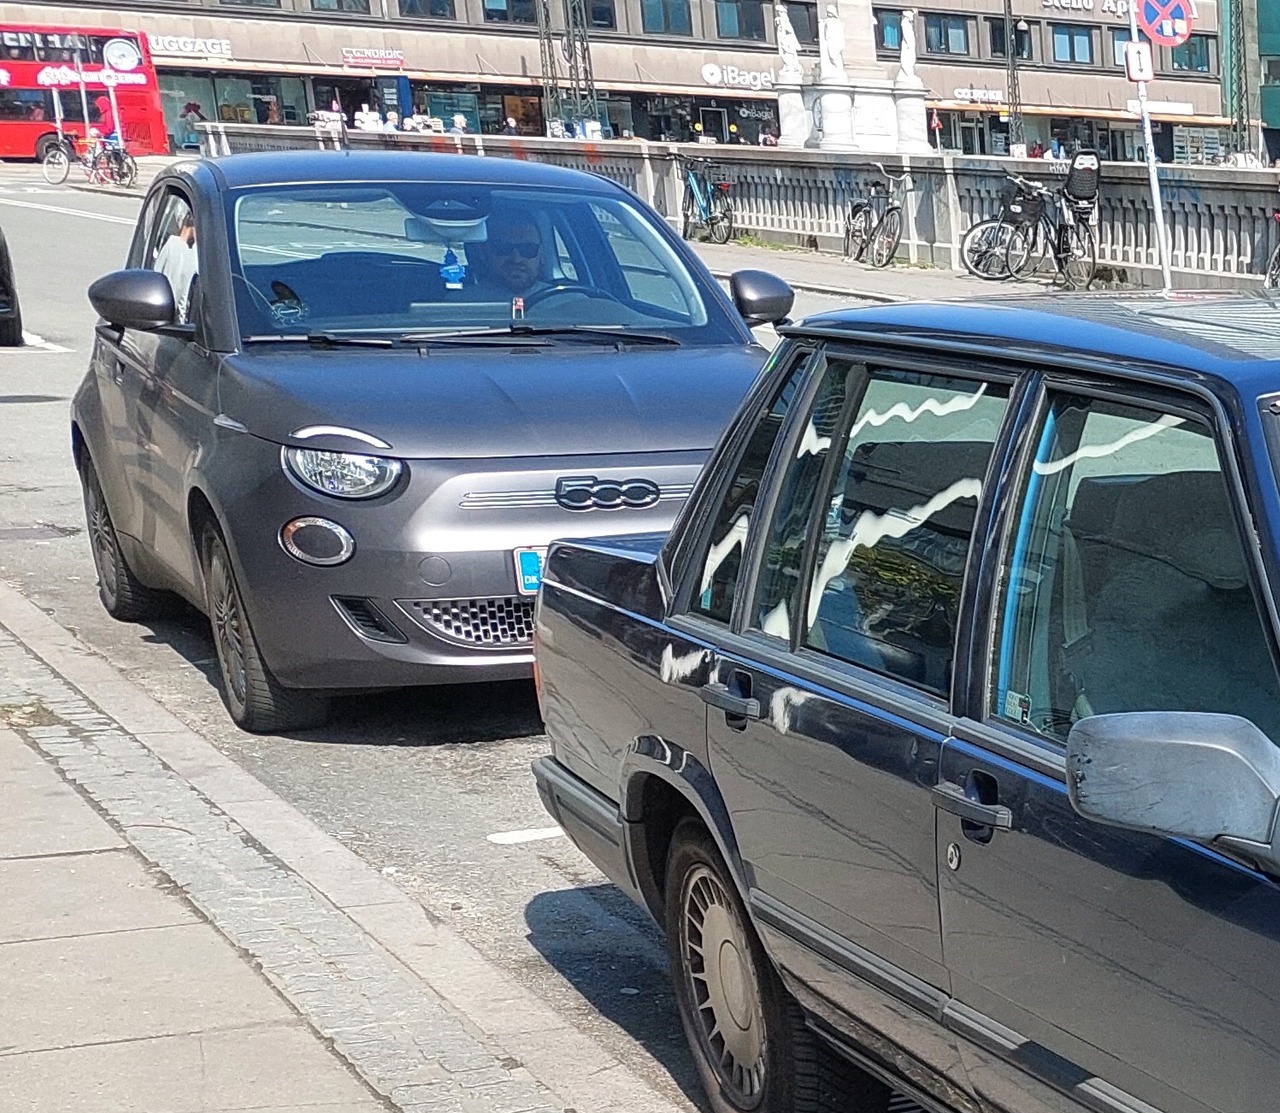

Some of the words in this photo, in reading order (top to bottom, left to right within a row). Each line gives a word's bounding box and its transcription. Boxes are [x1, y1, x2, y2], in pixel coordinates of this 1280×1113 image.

[150, 36, 232, 55] UGGAGE
[723, 65, 776, 90] iBagel
[555, 476, 661, 512] 500
[524, 575, 539, 584] DK
